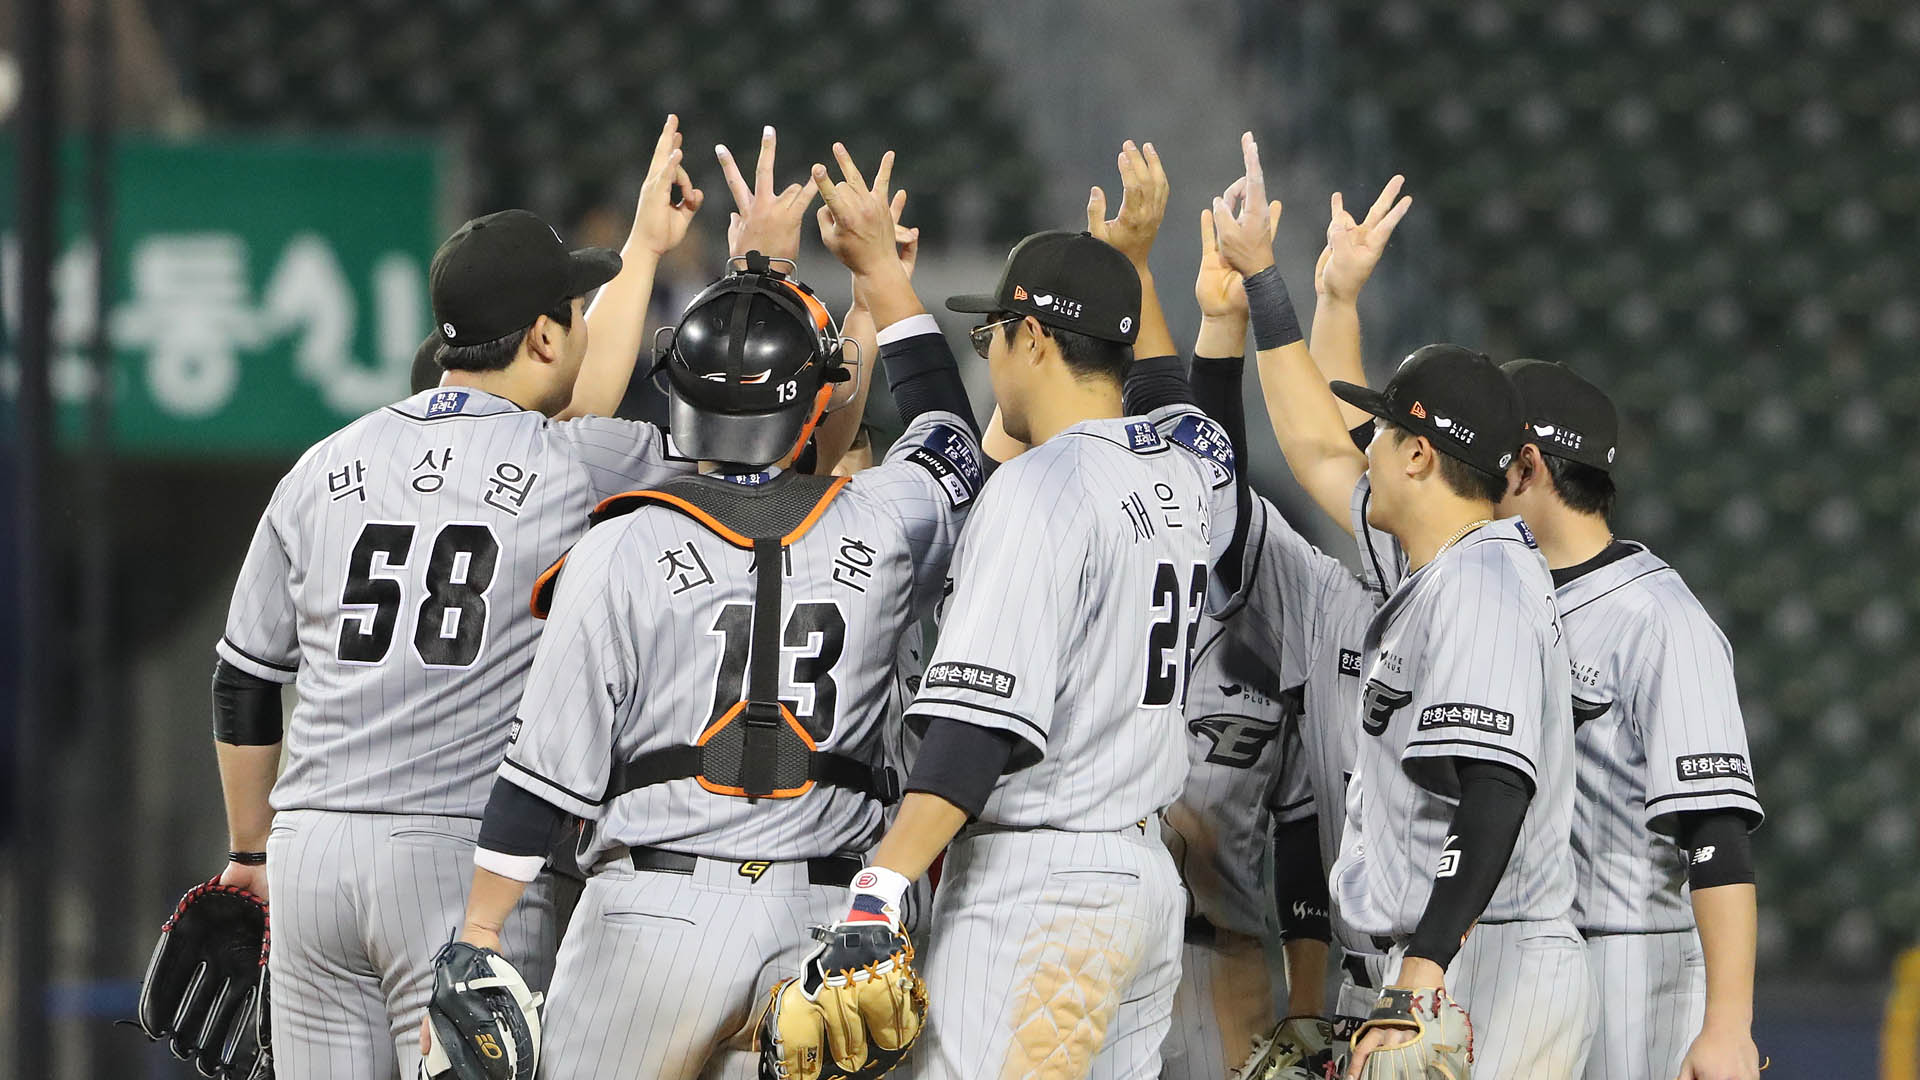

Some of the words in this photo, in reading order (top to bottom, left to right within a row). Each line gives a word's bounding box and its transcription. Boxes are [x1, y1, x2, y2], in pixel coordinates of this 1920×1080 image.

[1053, 305, 1080, 318] PLUS
[1055, 297, 1082, 311] LIFE
[776, 380, 797, 403] 13
[1449, 428, 1473, 444] PLUS
[1451, 422, 1475, 439] LIFE
[1556, 427, 1582, 443] LIFE
[1554, 436, 1580, 449] PLUS
[336, 519, 503, 670] 58
[1138, 559, 1207, 709] 22
[691, 600, 847, 751] 13
[1571, 669, 1595, 686] PLUS
[1573, 661, 1600, 678] LIFE
[928, 665, 1012, 694] 한화손해보험
[1422, 707, 1511, 731] 한화손해보험
